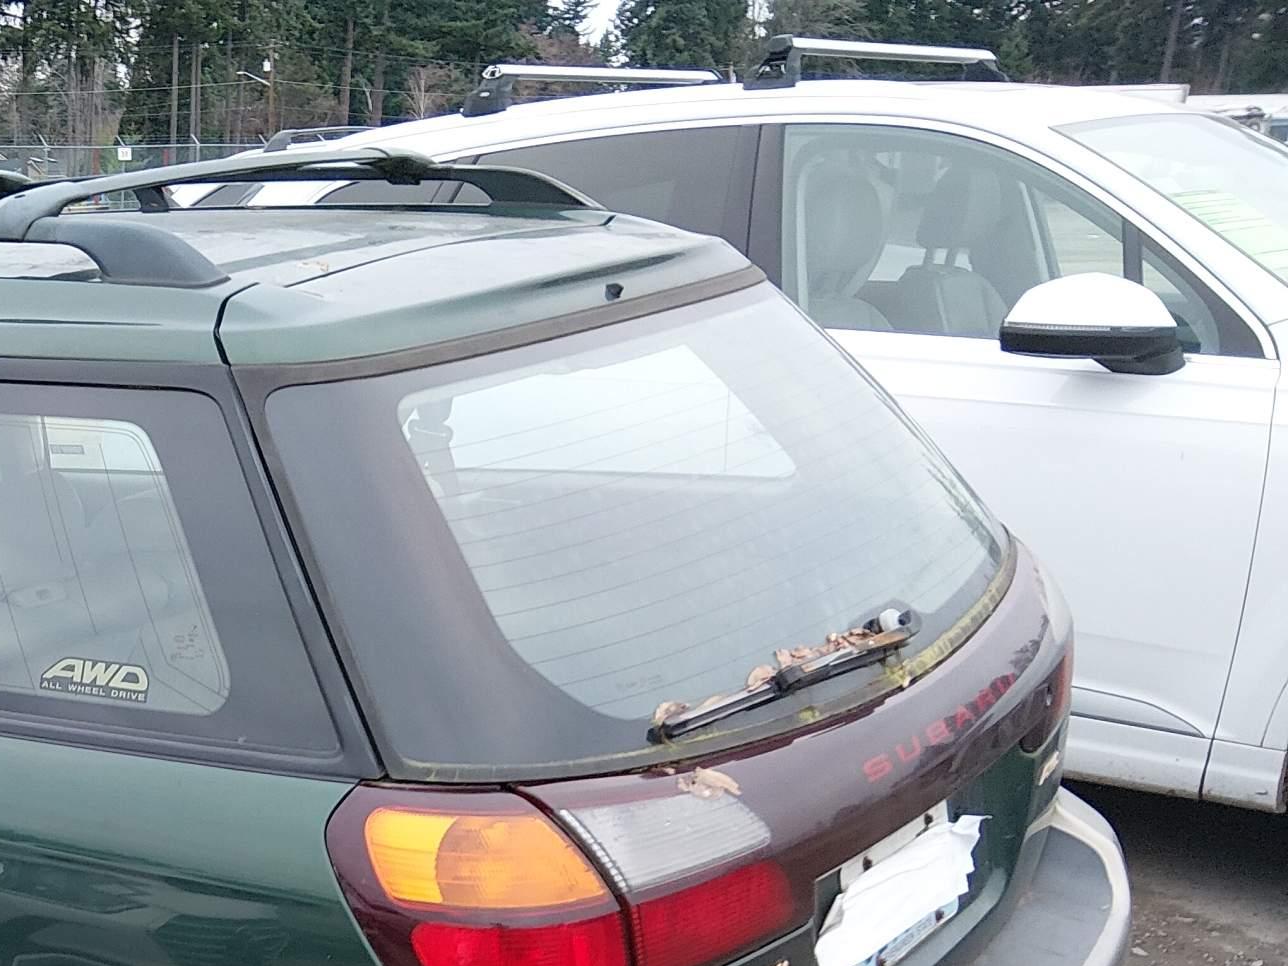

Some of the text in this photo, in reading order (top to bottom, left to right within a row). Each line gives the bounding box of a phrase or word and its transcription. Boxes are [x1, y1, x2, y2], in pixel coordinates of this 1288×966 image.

[41, 658, 149, 692] AWD
[41, 680, 146, 702] ALL WHEEL DRIVE
[863, 671, 1017, 783] SUBARU
